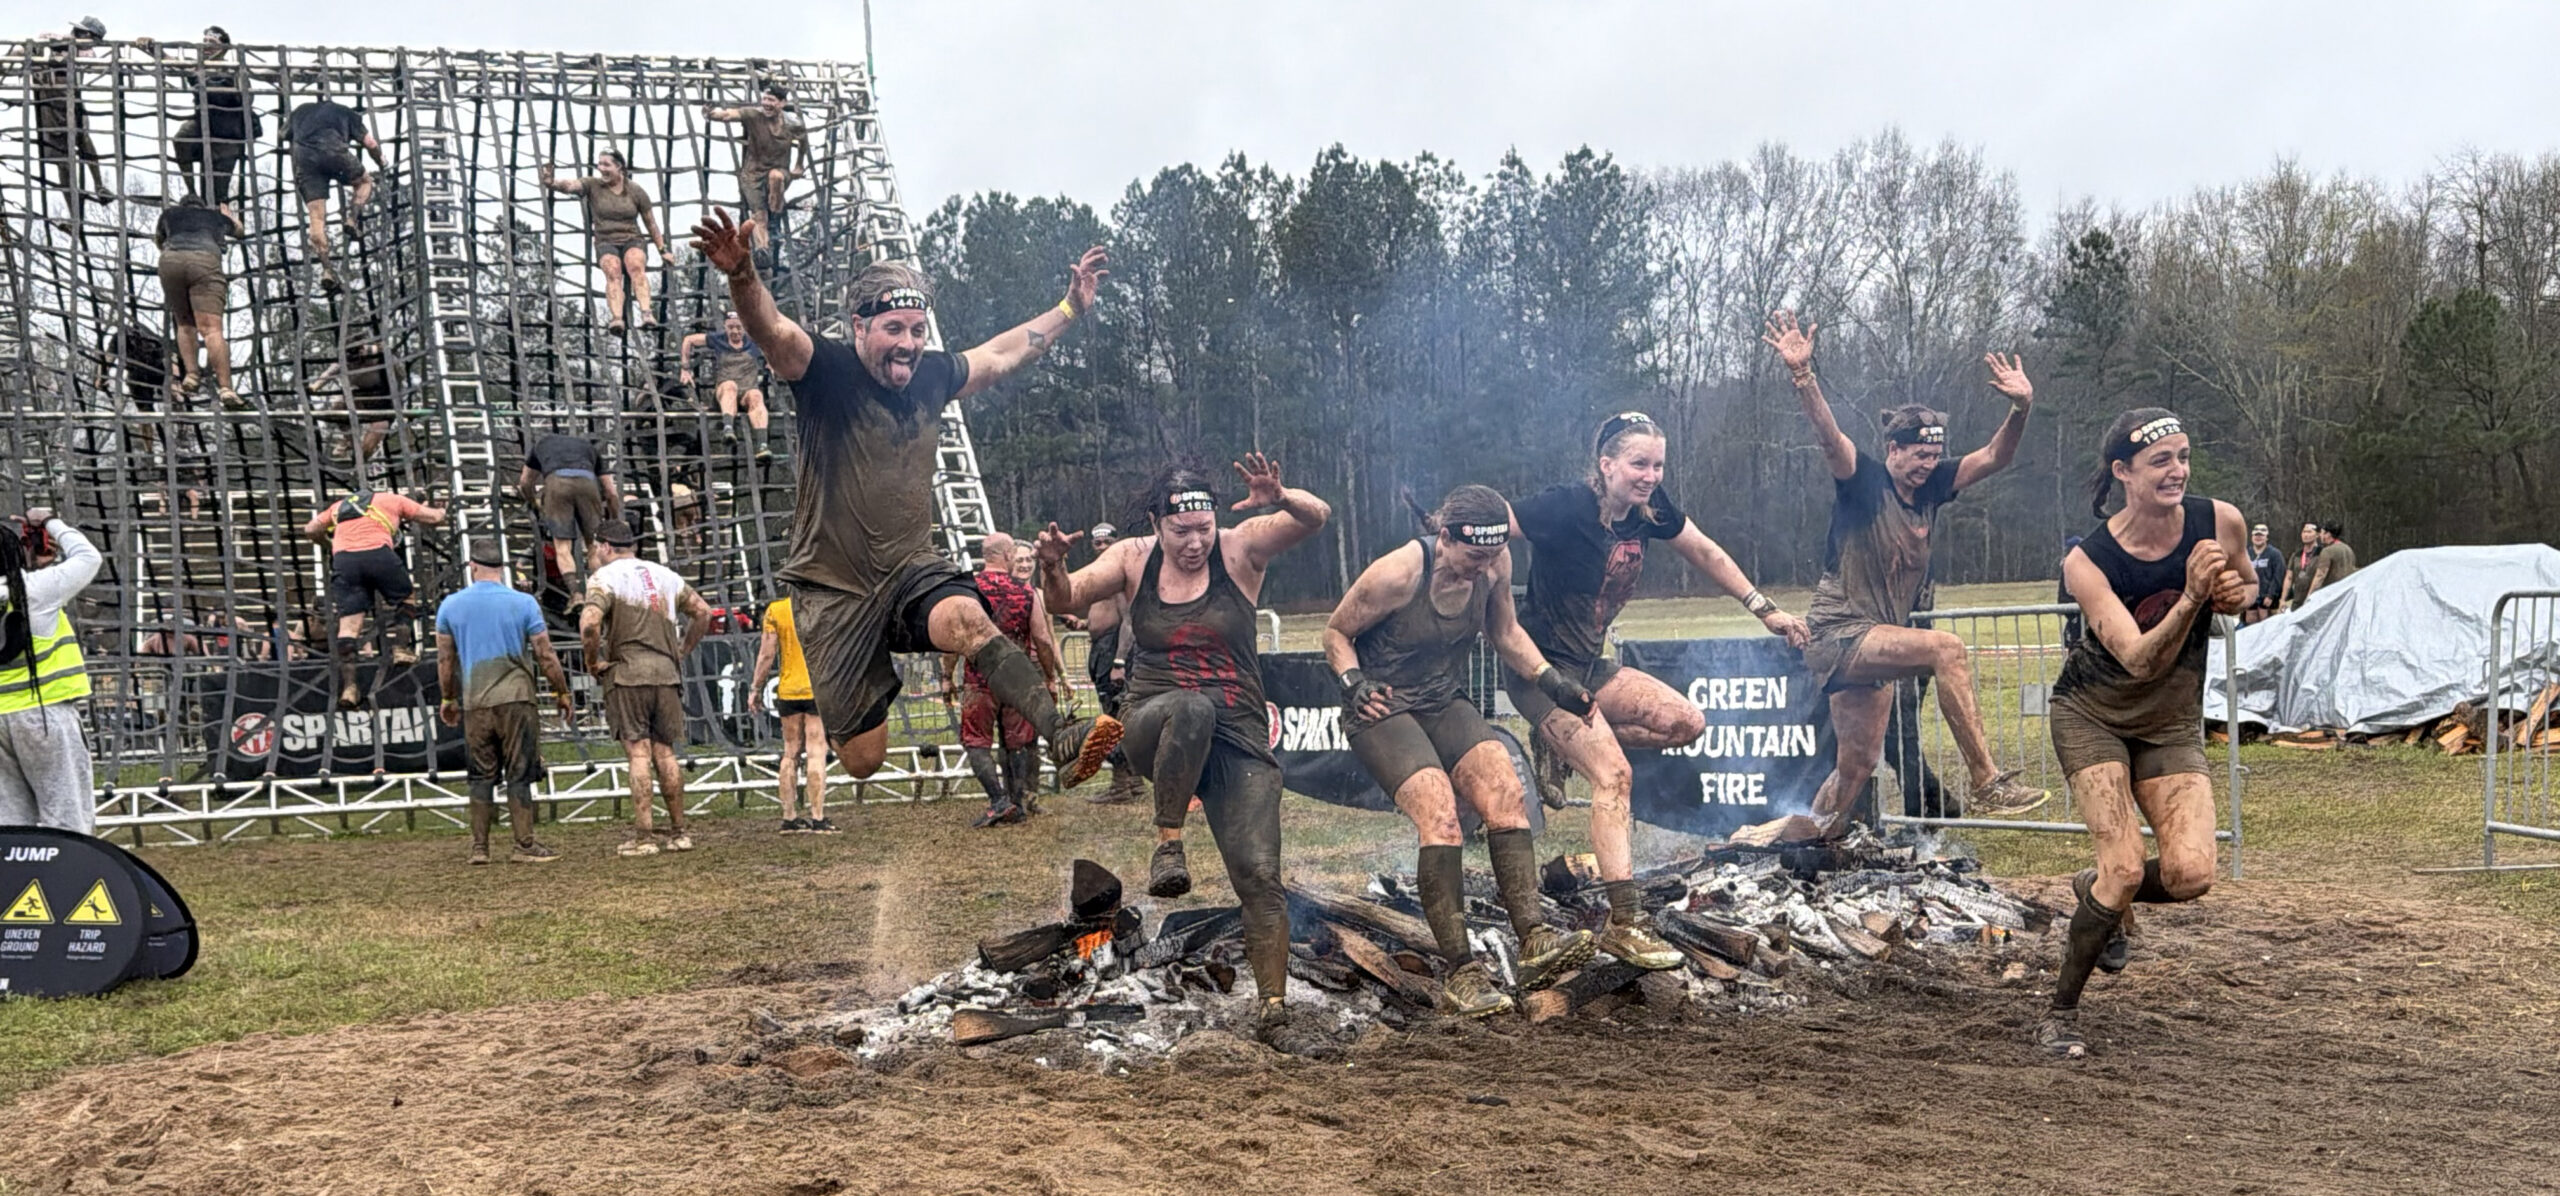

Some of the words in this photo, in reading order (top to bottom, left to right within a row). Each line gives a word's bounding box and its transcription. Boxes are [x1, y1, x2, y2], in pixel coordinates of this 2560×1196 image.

[1687, 676, 1788, 711] GREEN
[282, 704, 438, 752] SPARTAN
[1661, 723, 1817, 759] OUNTAIN
[1700, 772, 1768, 806] FIRE
[4, 847, 60, 862] JUMP
[4, 928, 42, 940] UNEVEN
[79, 928, 103, 940] TRIP
[0, 940, 40, 953] GROUND
[67, 941, 106, 954] HAZARD
